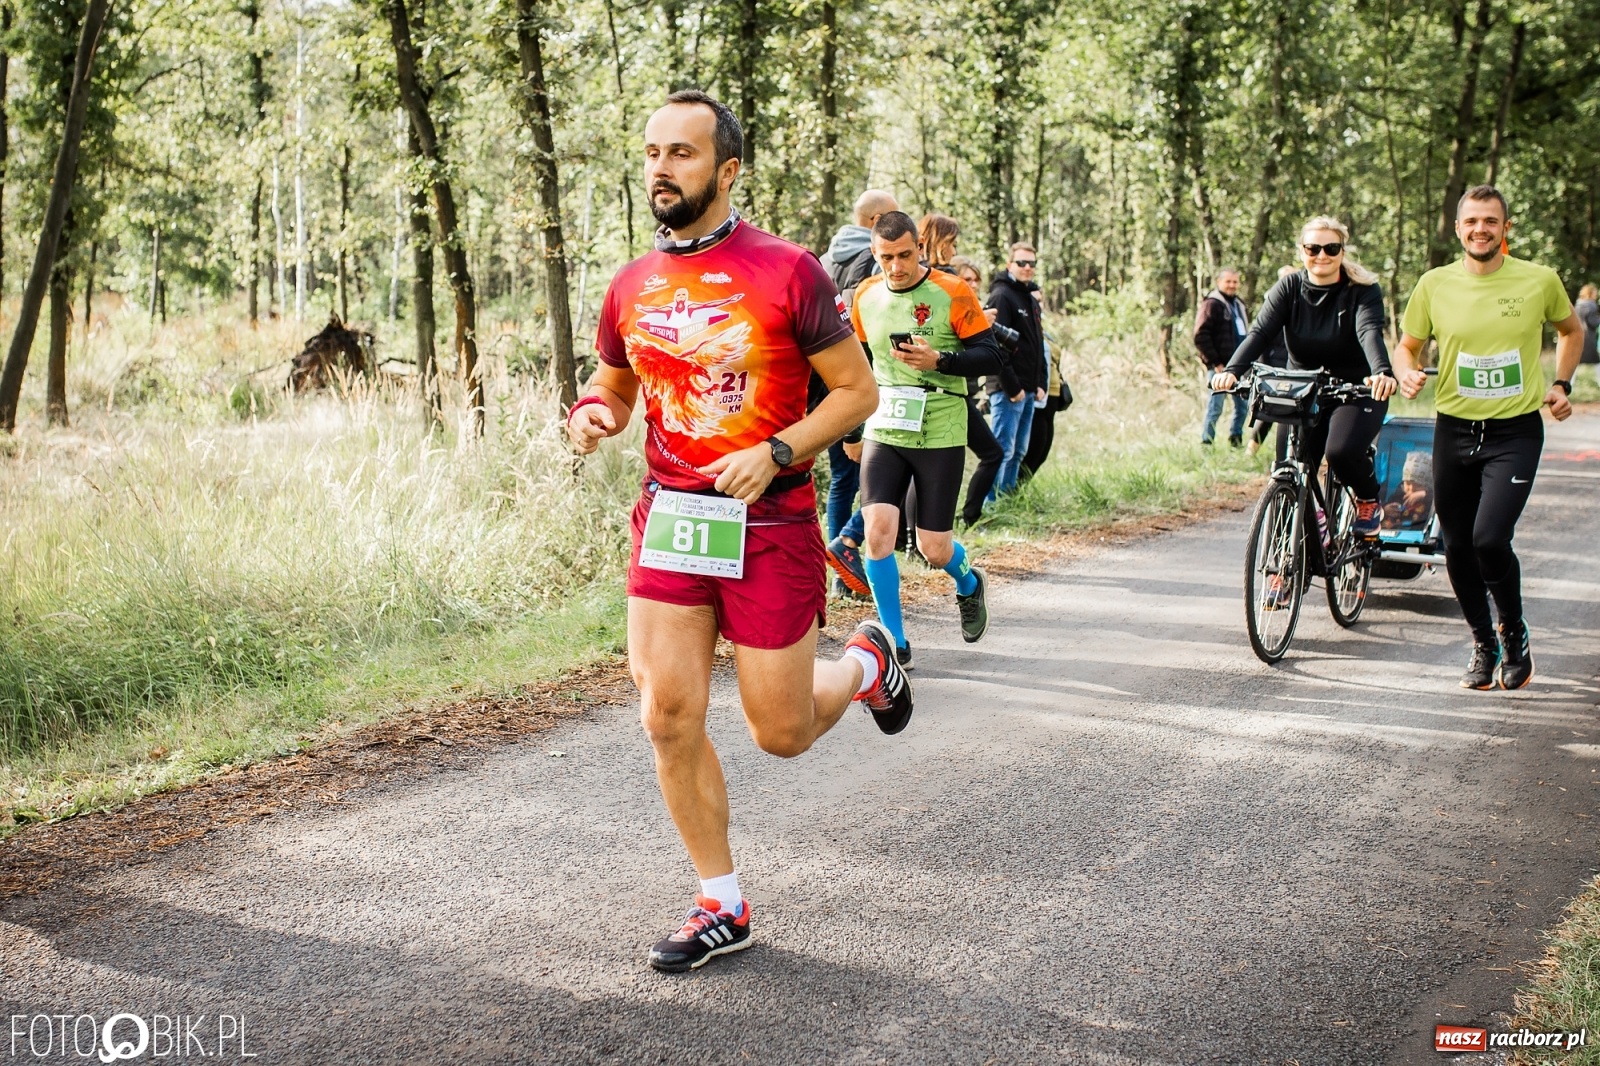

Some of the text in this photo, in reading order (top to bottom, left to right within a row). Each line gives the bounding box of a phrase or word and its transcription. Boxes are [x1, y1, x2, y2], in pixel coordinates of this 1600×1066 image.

[720, 371, 748, 393] 21
[1473, 368, 1505, 389] 80
[728, 404, 742, 414] KM
[672, 519, 710, 554] 81
